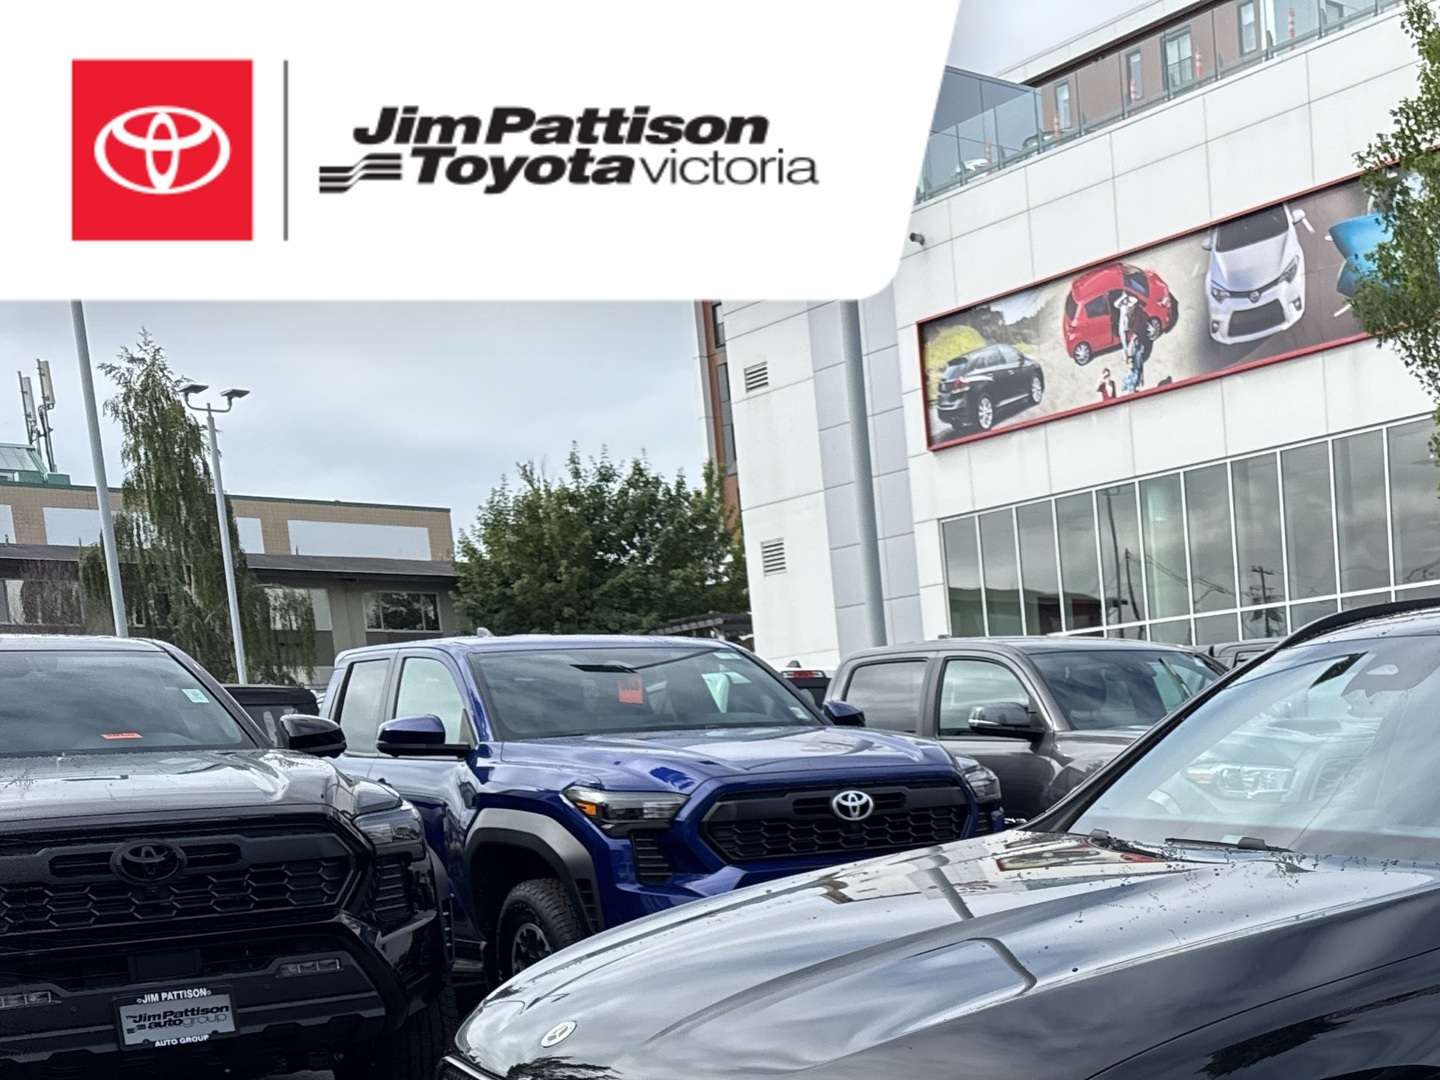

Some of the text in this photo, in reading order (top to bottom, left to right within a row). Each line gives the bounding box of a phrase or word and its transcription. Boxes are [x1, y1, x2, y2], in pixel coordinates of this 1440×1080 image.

[142, 988, 207, 1004] JIM PATTISON
[154, 1034, 210, 1048] AUTO GROUP
